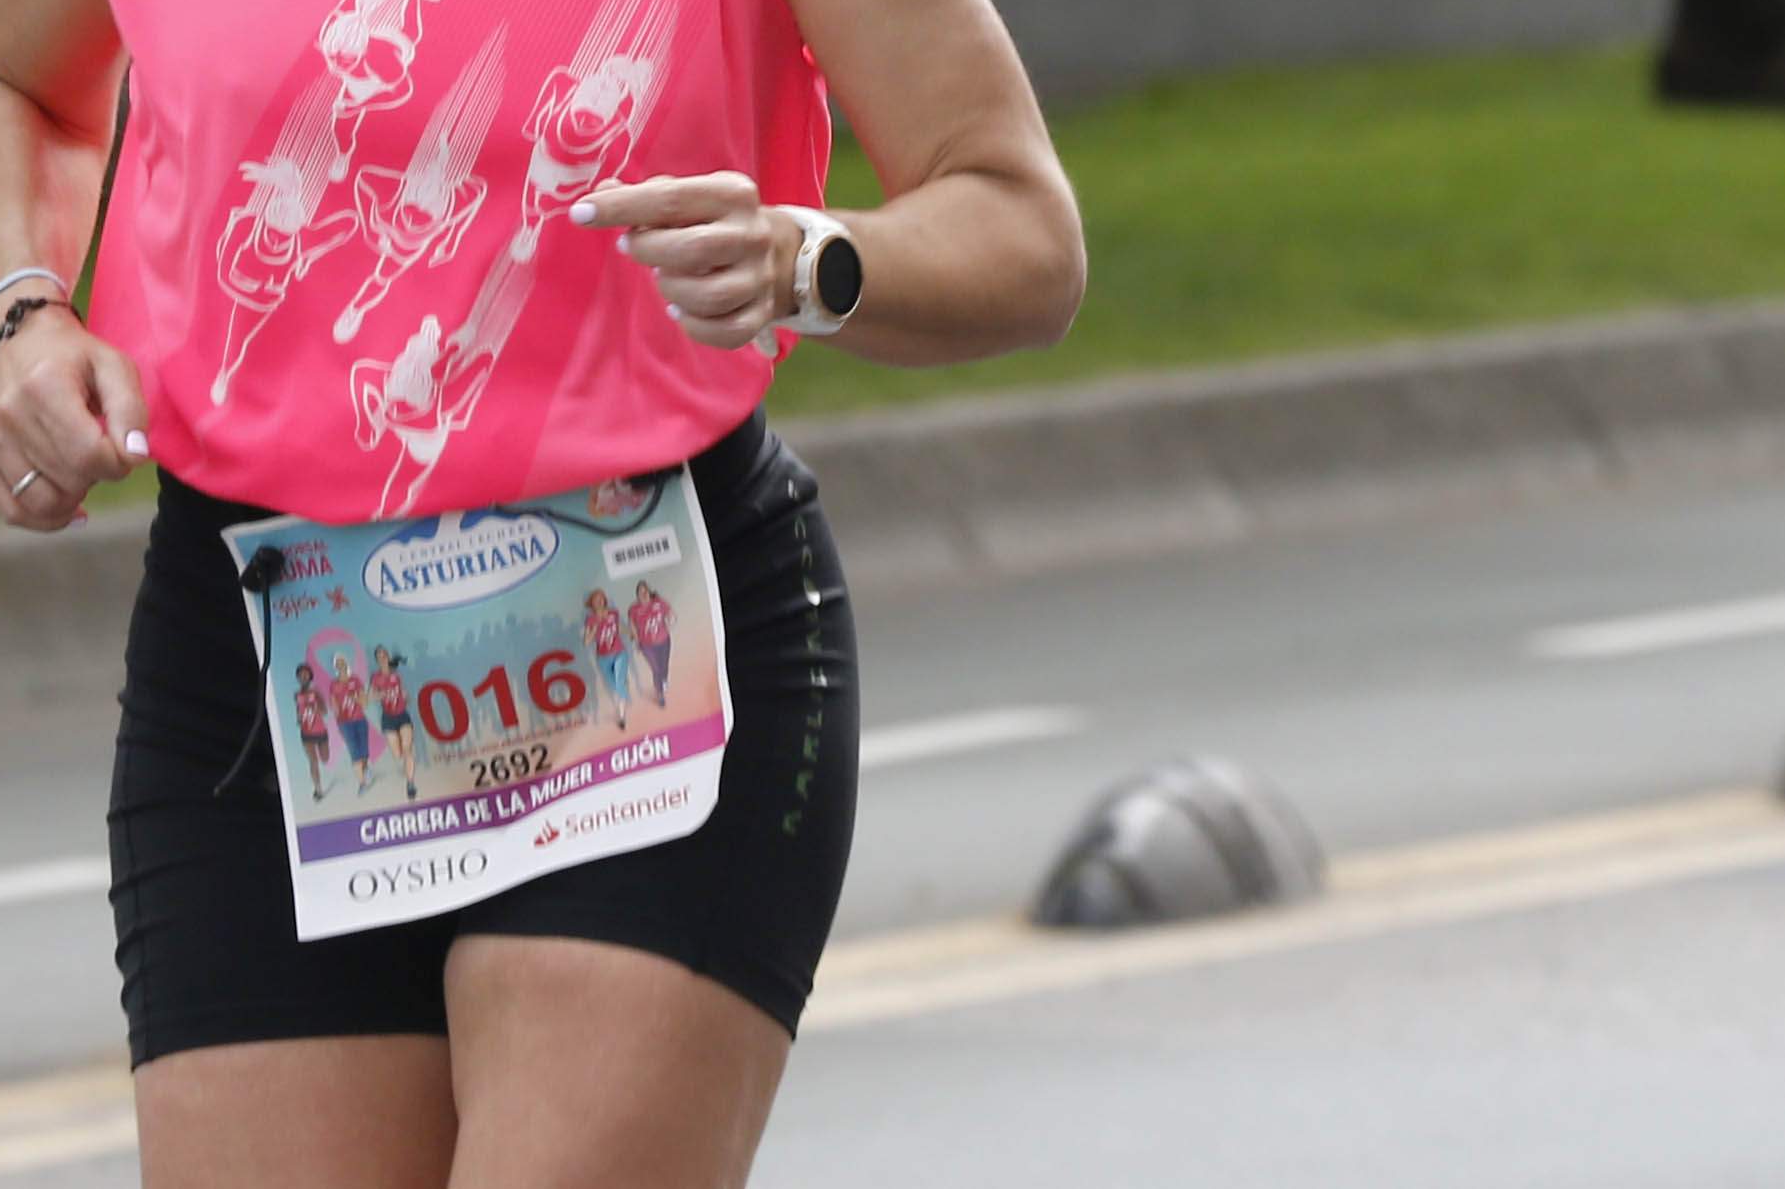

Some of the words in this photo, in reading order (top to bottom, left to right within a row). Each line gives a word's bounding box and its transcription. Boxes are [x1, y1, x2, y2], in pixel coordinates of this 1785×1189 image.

[377, 534, 546, 597] ASTURIANA
[417, 649, 587, 744] 016
[360, 803, 460, 845] CARRERA
[464, 797, 492, 826] DE
[495, 789, 526, 819] LA
[529, 761, 593, 808] MUJER
[610, 733, 671, 774] GIJÓN
[469, 742, 554, 789] 2692
[565, 784, 691, 838] Santander
[347, 847, 488, 902] OYSHO
